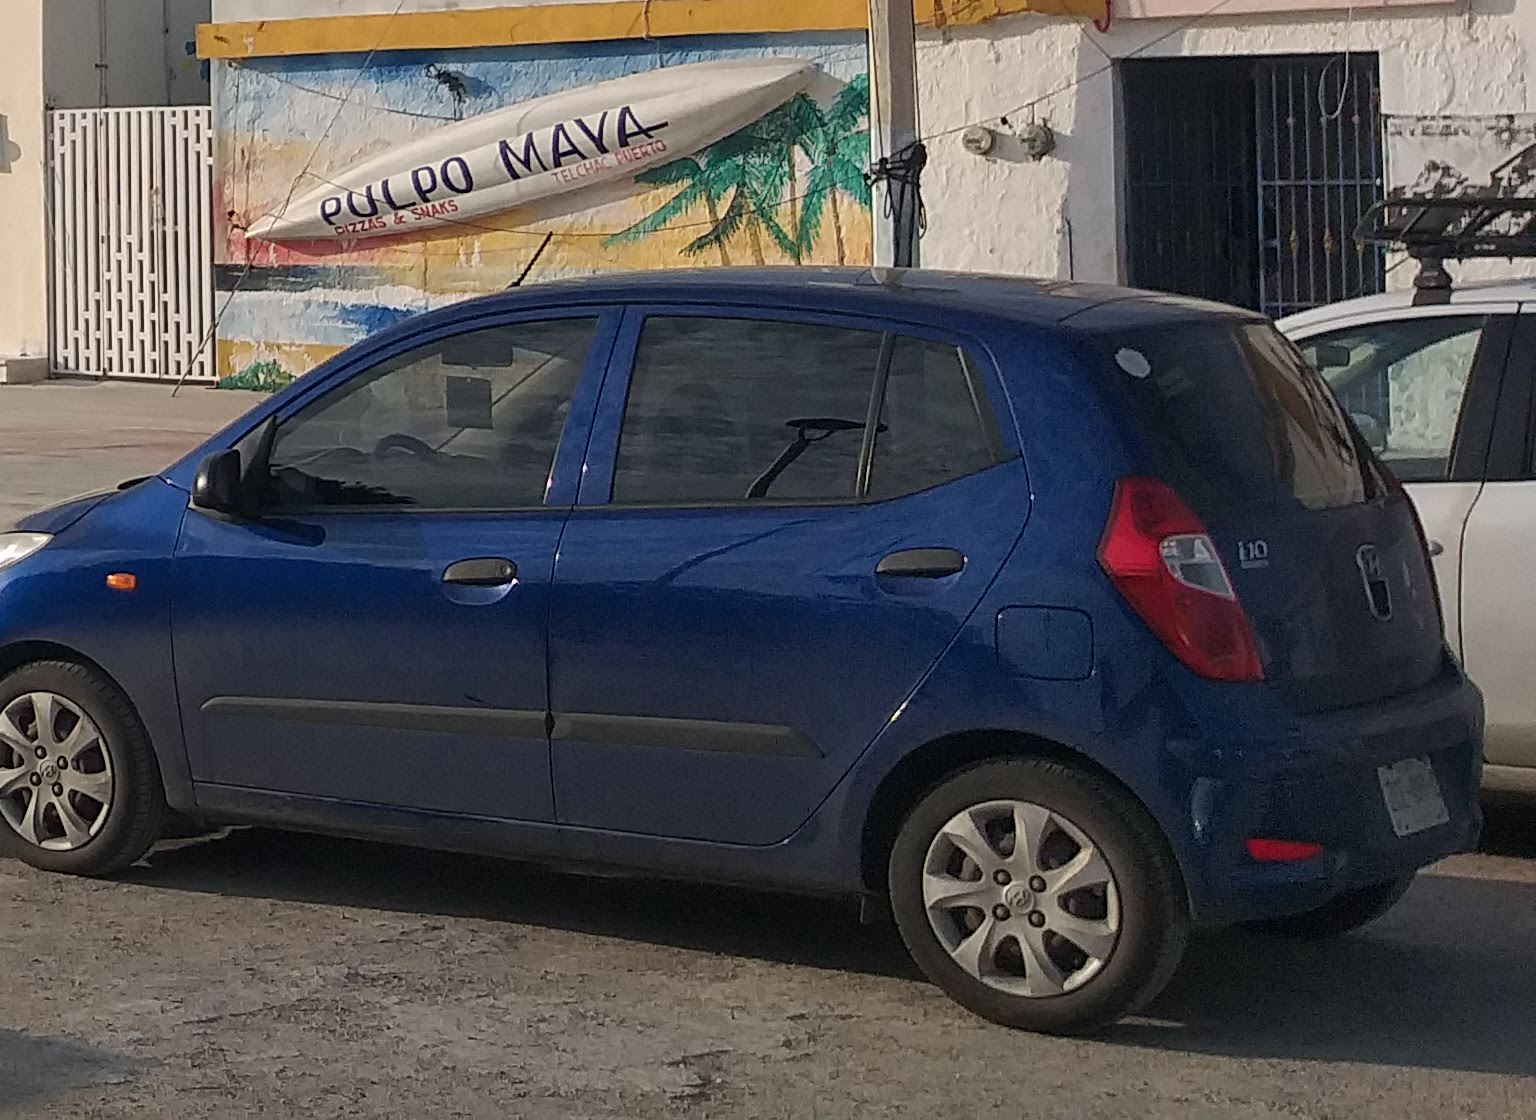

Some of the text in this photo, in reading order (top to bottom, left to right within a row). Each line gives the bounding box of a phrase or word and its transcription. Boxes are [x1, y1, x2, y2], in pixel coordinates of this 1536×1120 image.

[320, 105, 670, 226] PULPO MAYA
[551, 138, 667, 184] TELCHAC PUERTO
[334, 199, 459, 236] PIZZAS & SNAKS
[1238, 540, 1268, 561] i10
